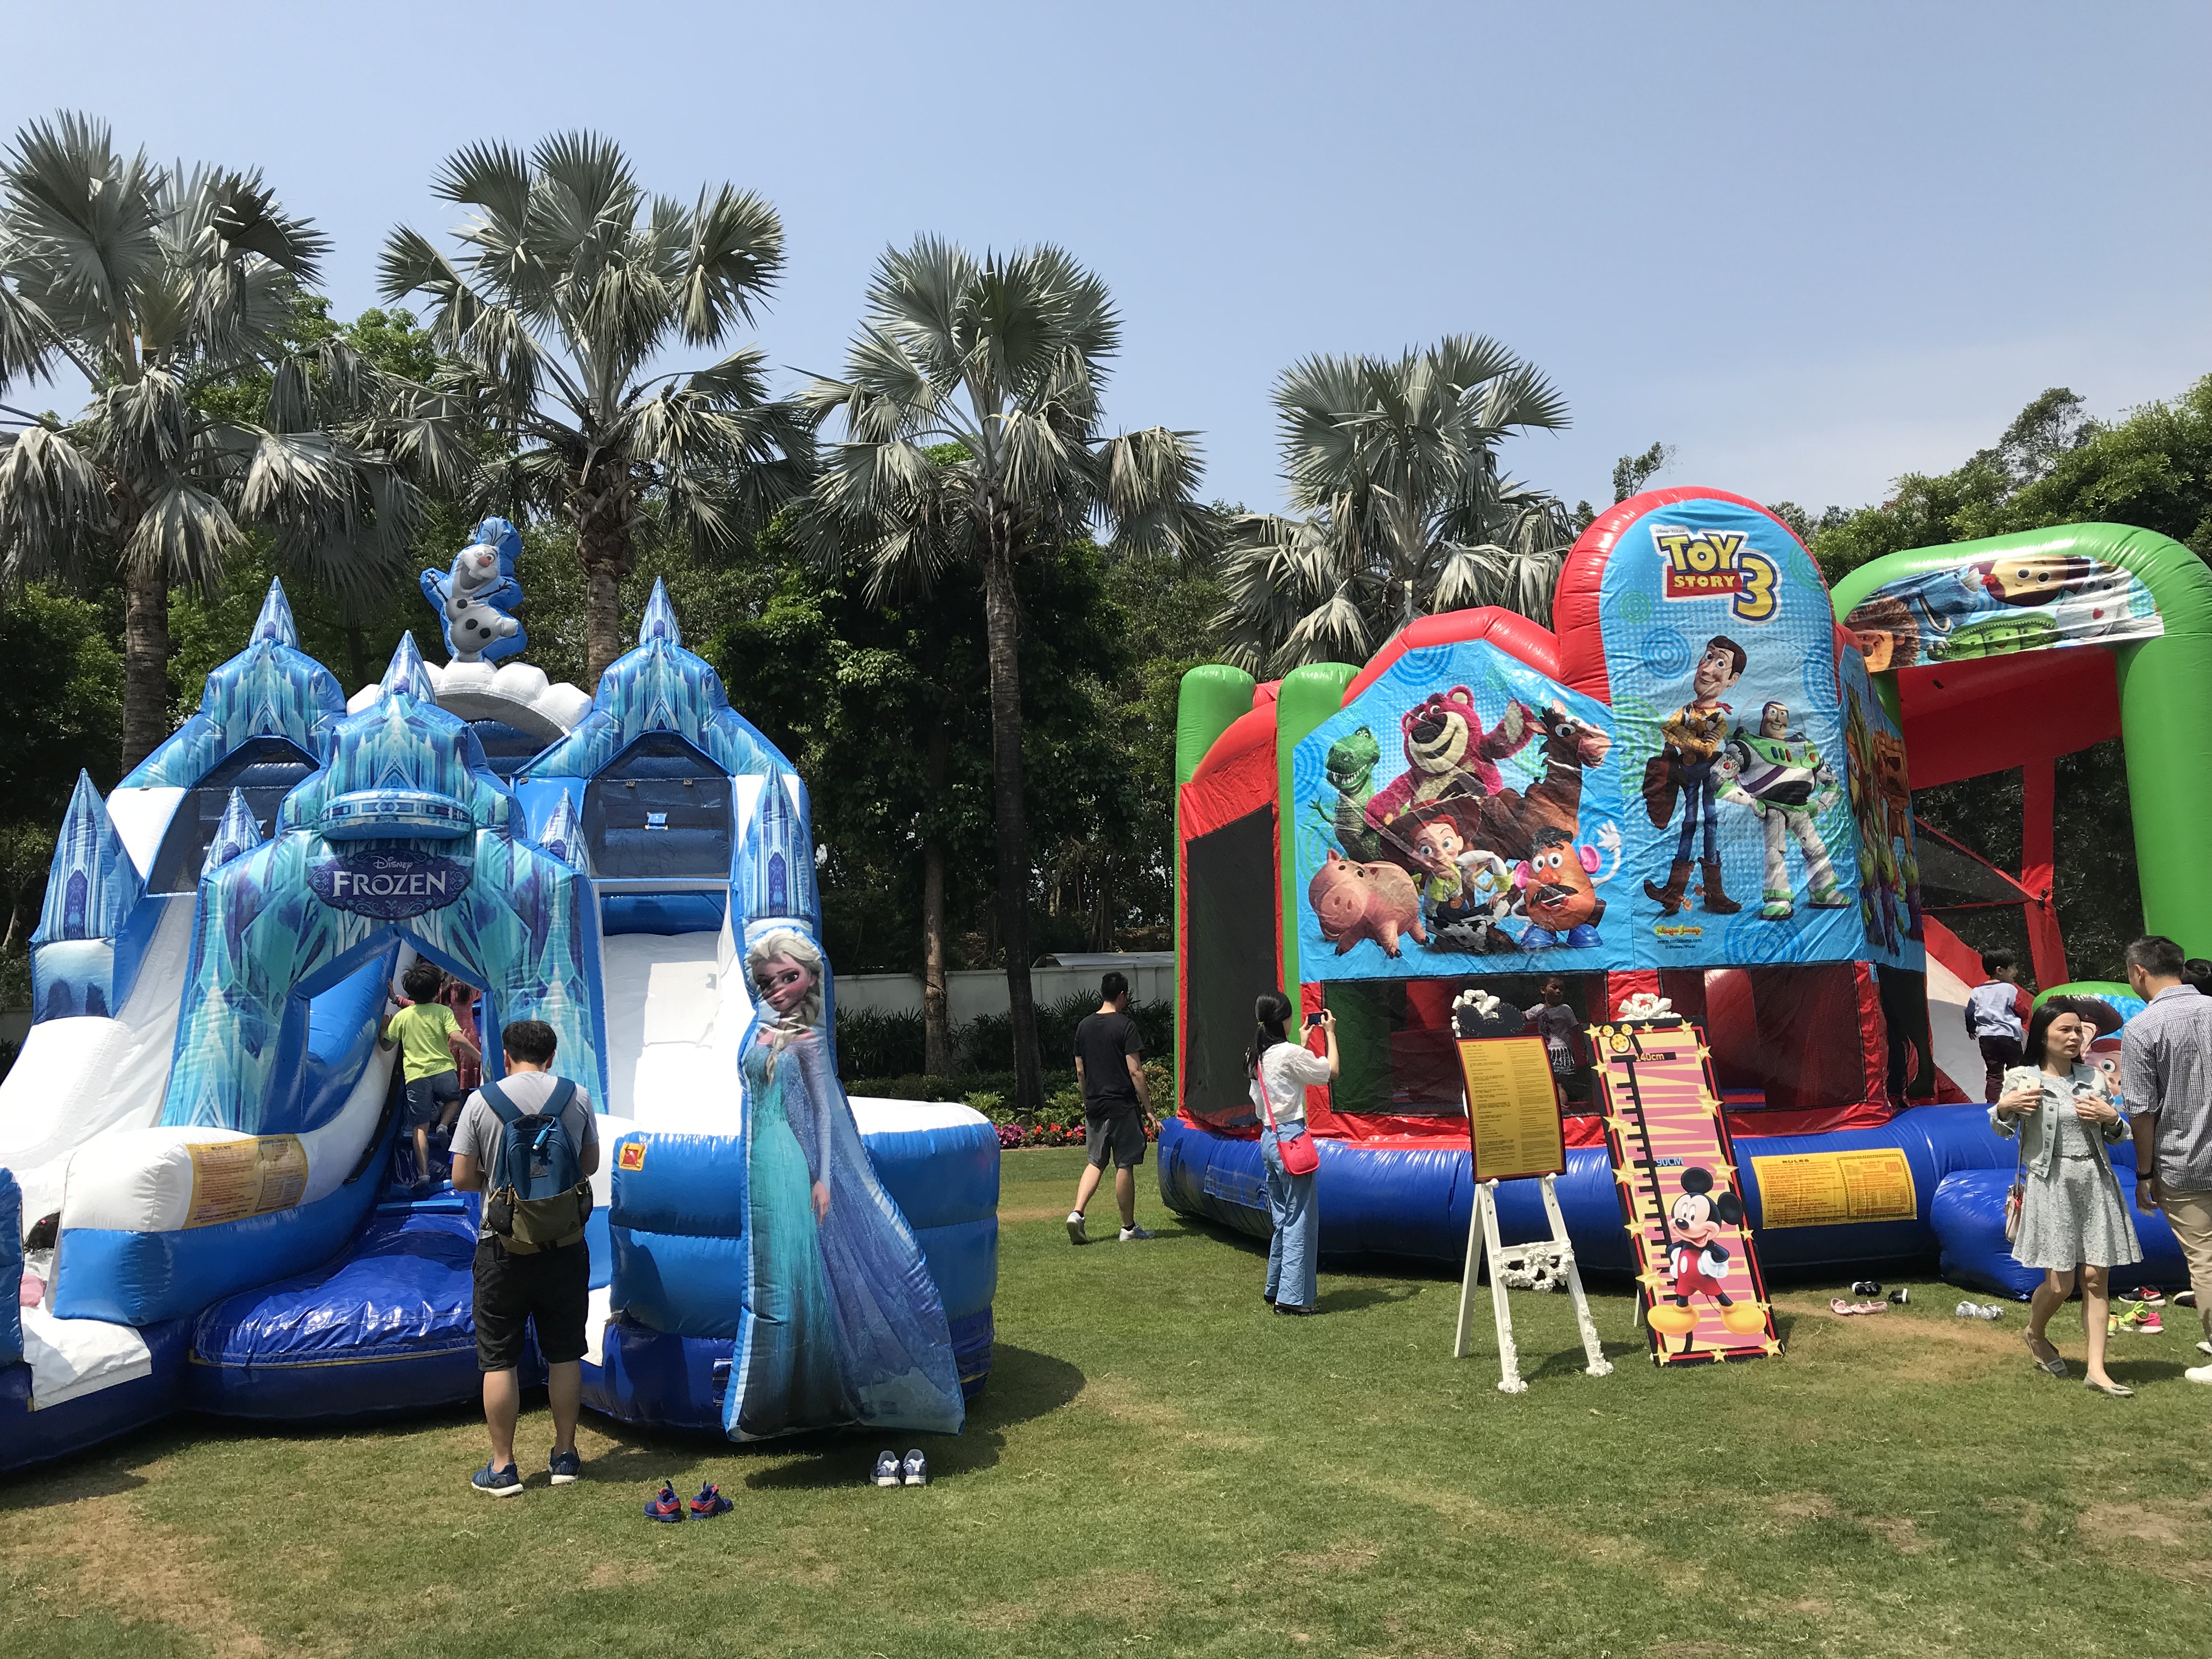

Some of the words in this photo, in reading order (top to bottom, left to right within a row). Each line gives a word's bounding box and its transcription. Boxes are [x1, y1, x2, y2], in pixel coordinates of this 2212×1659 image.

[1657, 533, 1745, 574] TOY
[1674, 575, 1736, 588] STORY
[1733, 552, 1778, 621] 3
[331, 870, 447, 898] FROZEN
[1635, 1053, 1665, 1062] 140cm
[1656, 1156, 1684, 1167] 90CM
